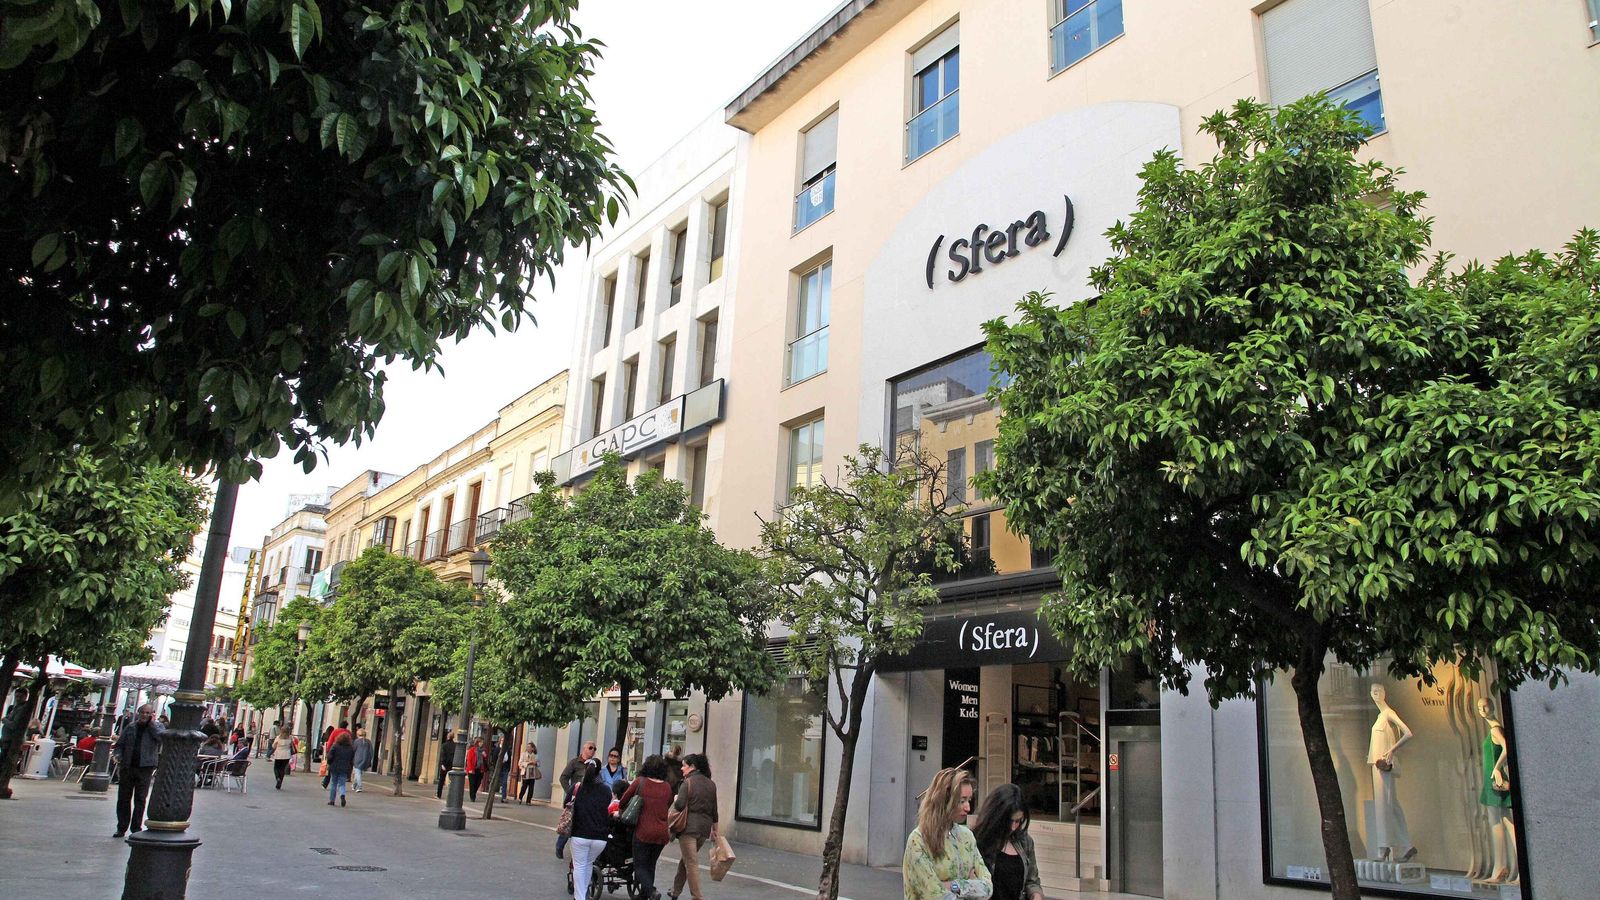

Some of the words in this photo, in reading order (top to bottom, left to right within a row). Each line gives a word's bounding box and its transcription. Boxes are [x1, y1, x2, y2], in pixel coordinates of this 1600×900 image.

[591, 414, 657, 459] GAPC
[949, 680, 978, 692] Women
[961, 694, 978, 705] Men
[960, 707, 978, 718] Kids
